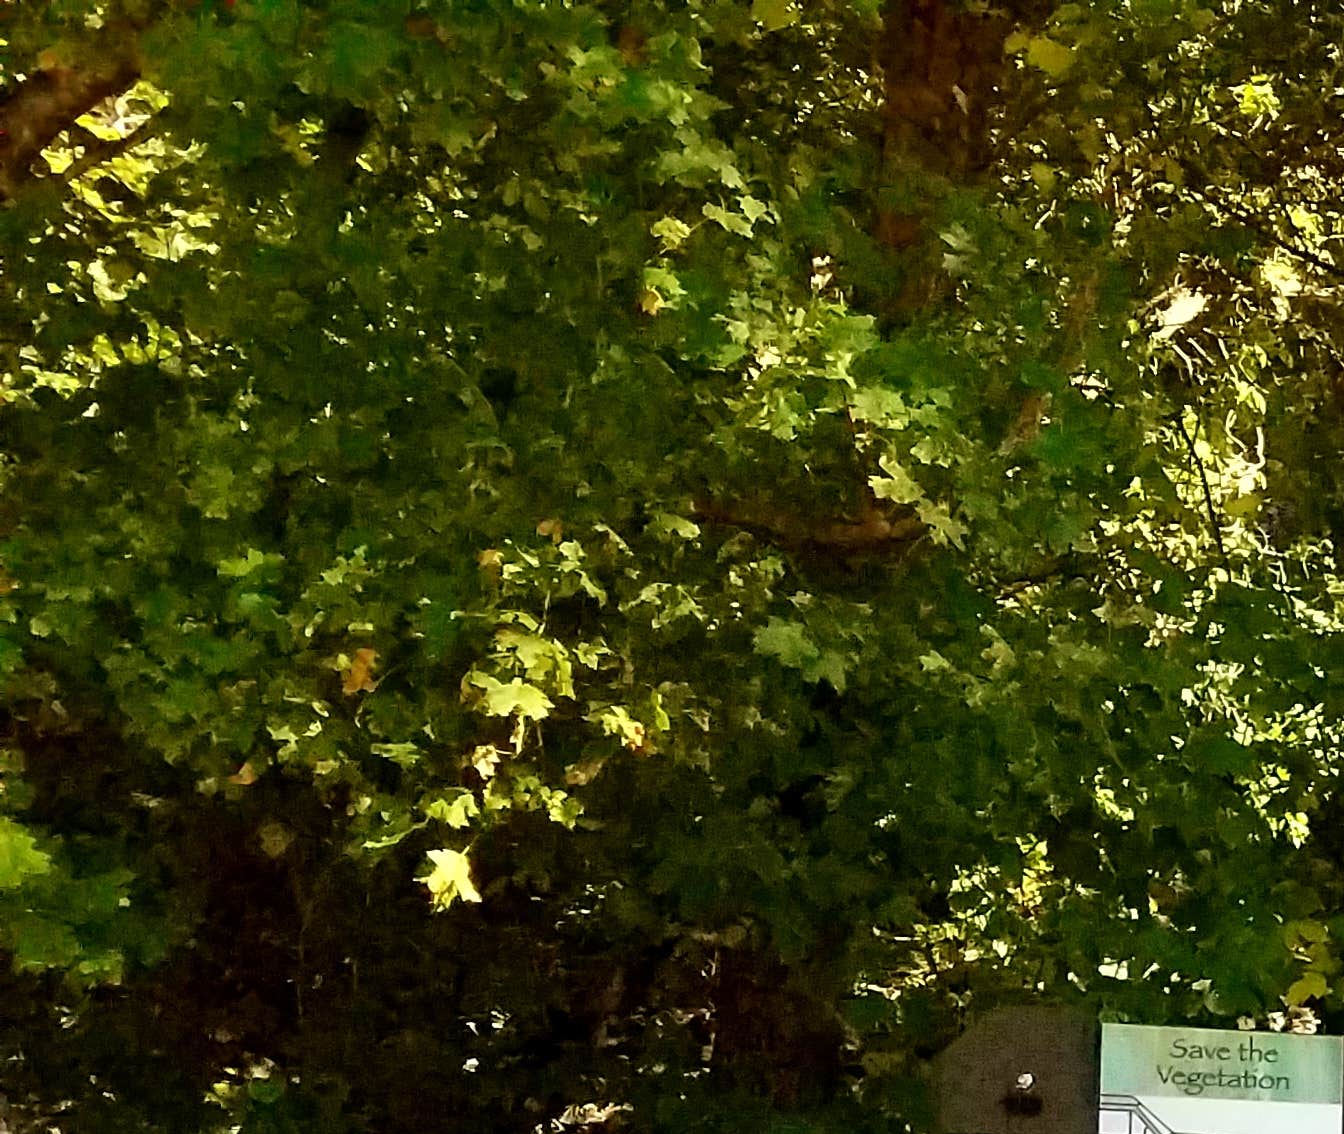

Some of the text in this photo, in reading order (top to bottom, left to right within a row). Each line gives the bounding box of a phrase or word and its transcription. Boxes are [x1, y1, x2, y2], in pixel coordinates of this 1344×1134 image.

[1170, 1036, 1279, 1062] Save the
[1156, 1064, 1290, 1094] Vegetation
